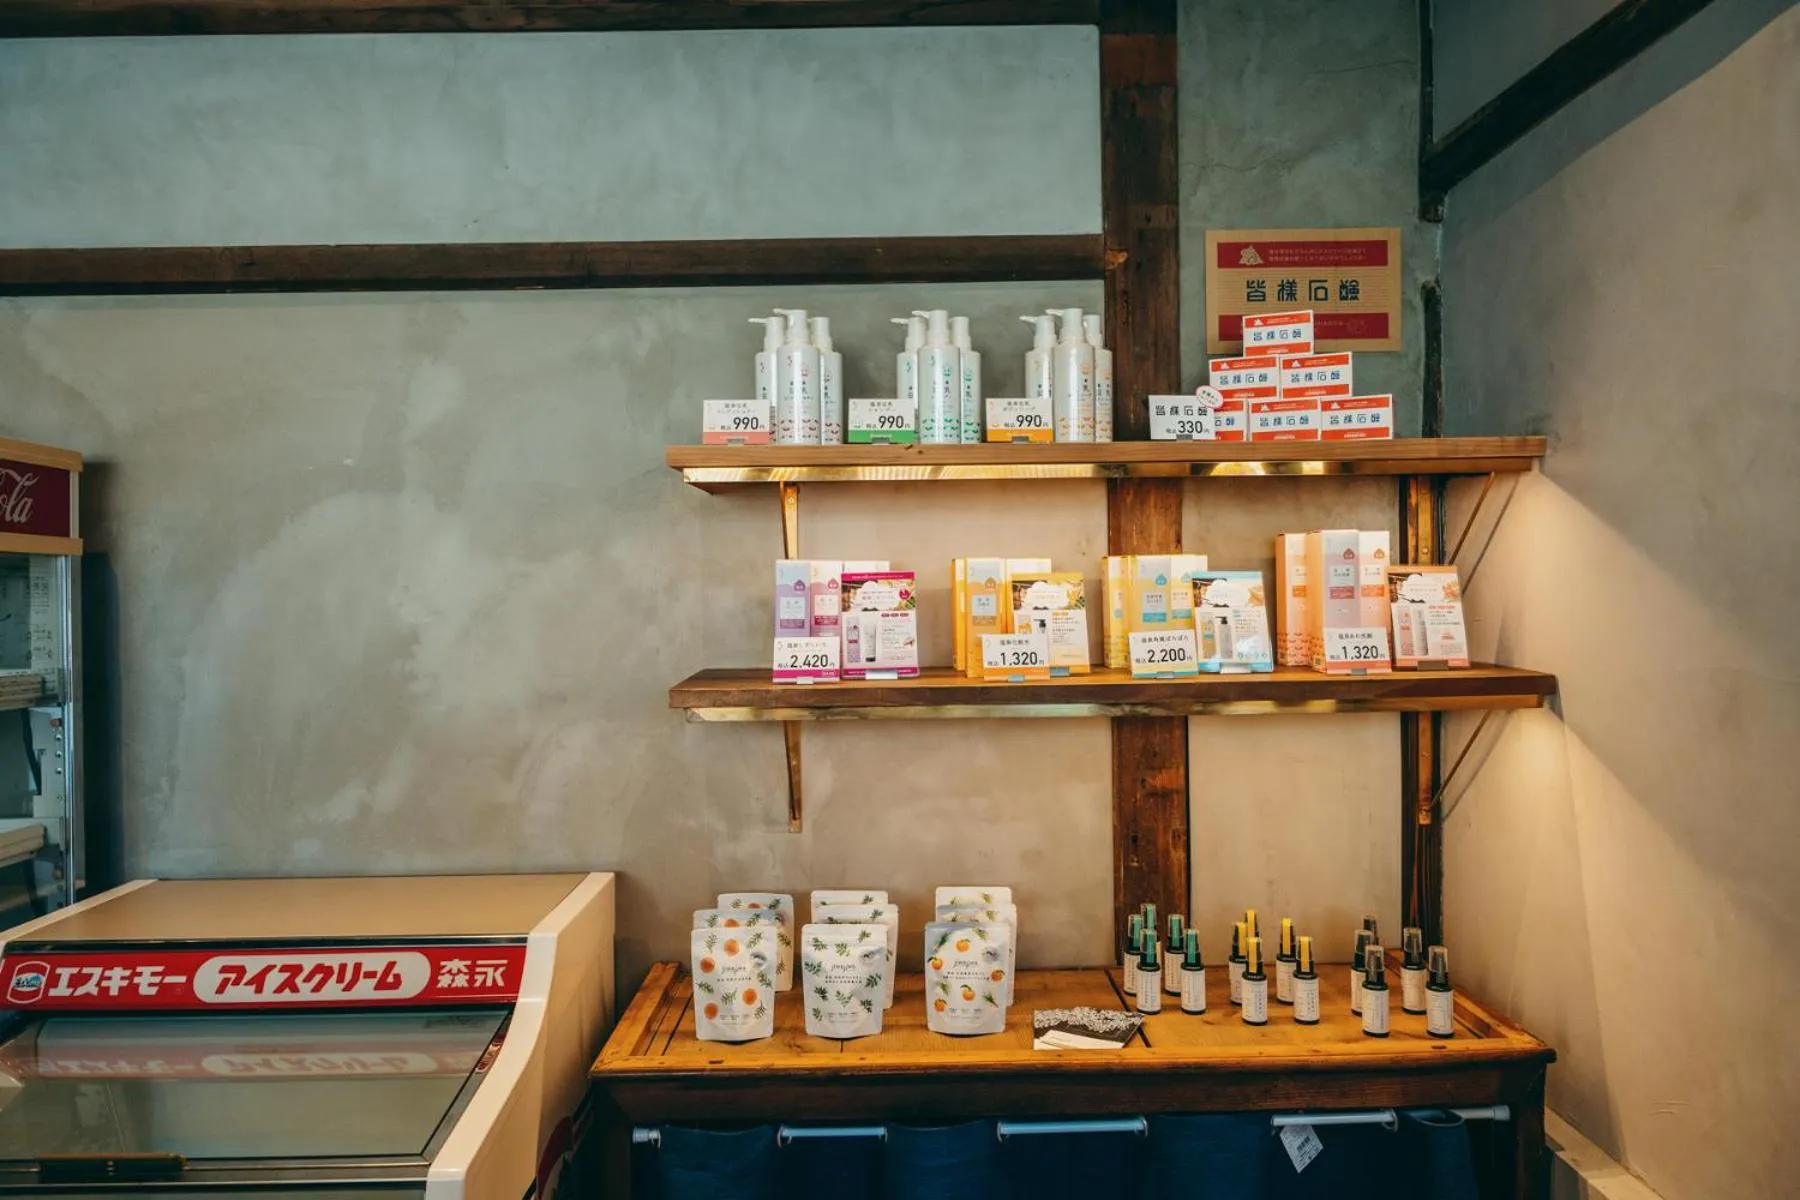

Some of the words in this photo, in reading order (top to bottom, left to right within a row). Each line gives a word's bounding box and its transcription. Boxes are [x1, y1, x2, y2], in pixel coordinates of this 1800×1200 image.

[48, 966, 187, 997] エスキモー
[214, 960, 403, 995] アイスクリーム
[435, 959, 507, 988] 森永
